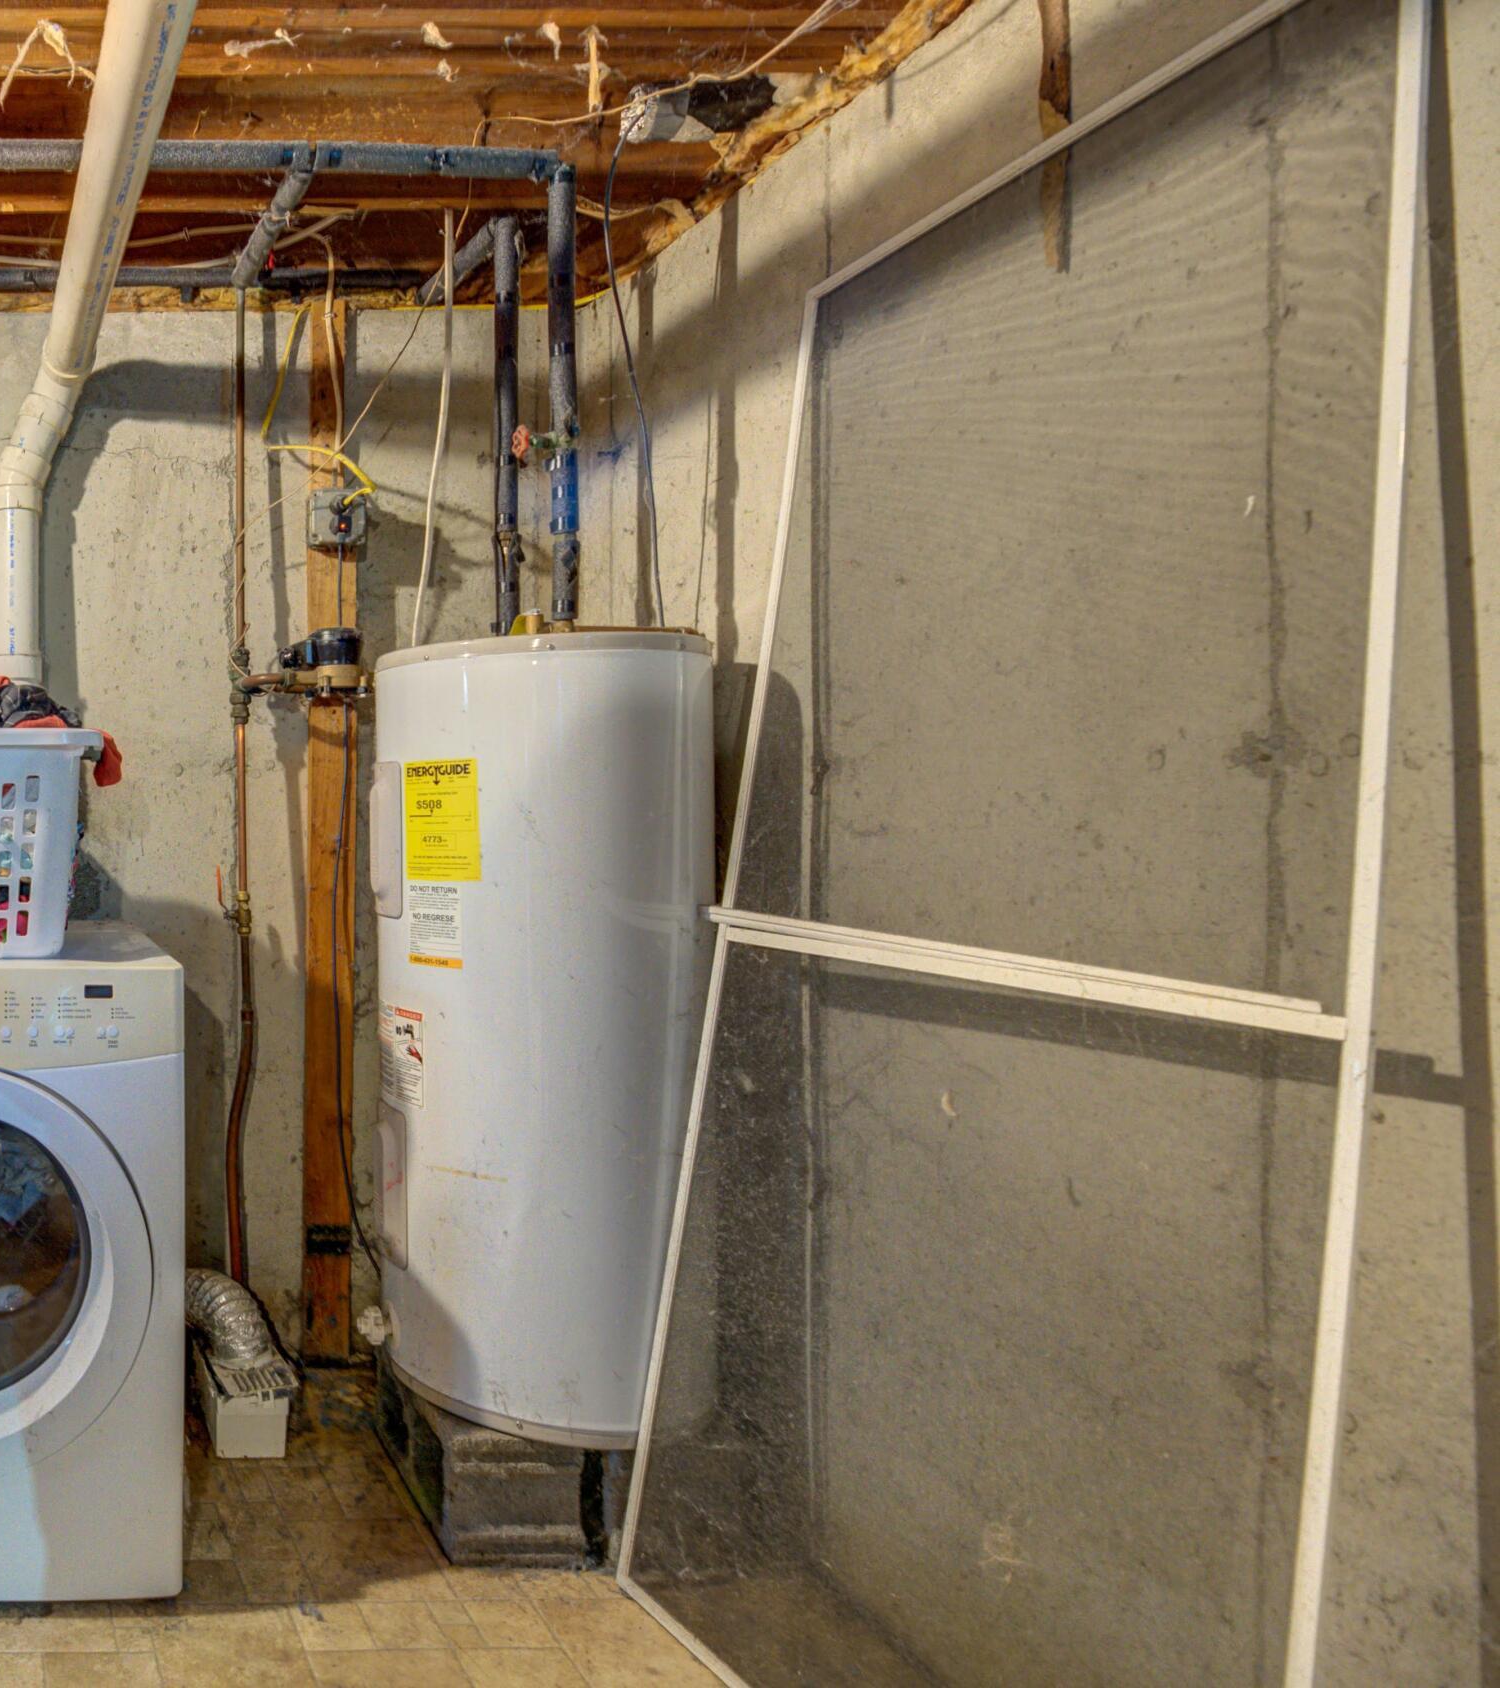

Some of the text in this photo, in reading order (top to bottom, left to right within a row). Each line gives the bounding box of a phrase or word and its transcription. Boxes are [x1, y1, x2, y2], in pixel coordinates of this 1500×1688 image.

[406, 763, 471, 779] ENERGYGUIDE
[416, 800, 442, 810] $508
[422, 835, 442, 843] 4773
[431, 886, 458, 895] RETURN
[412, 912, 456, 923] NO REGRESE
